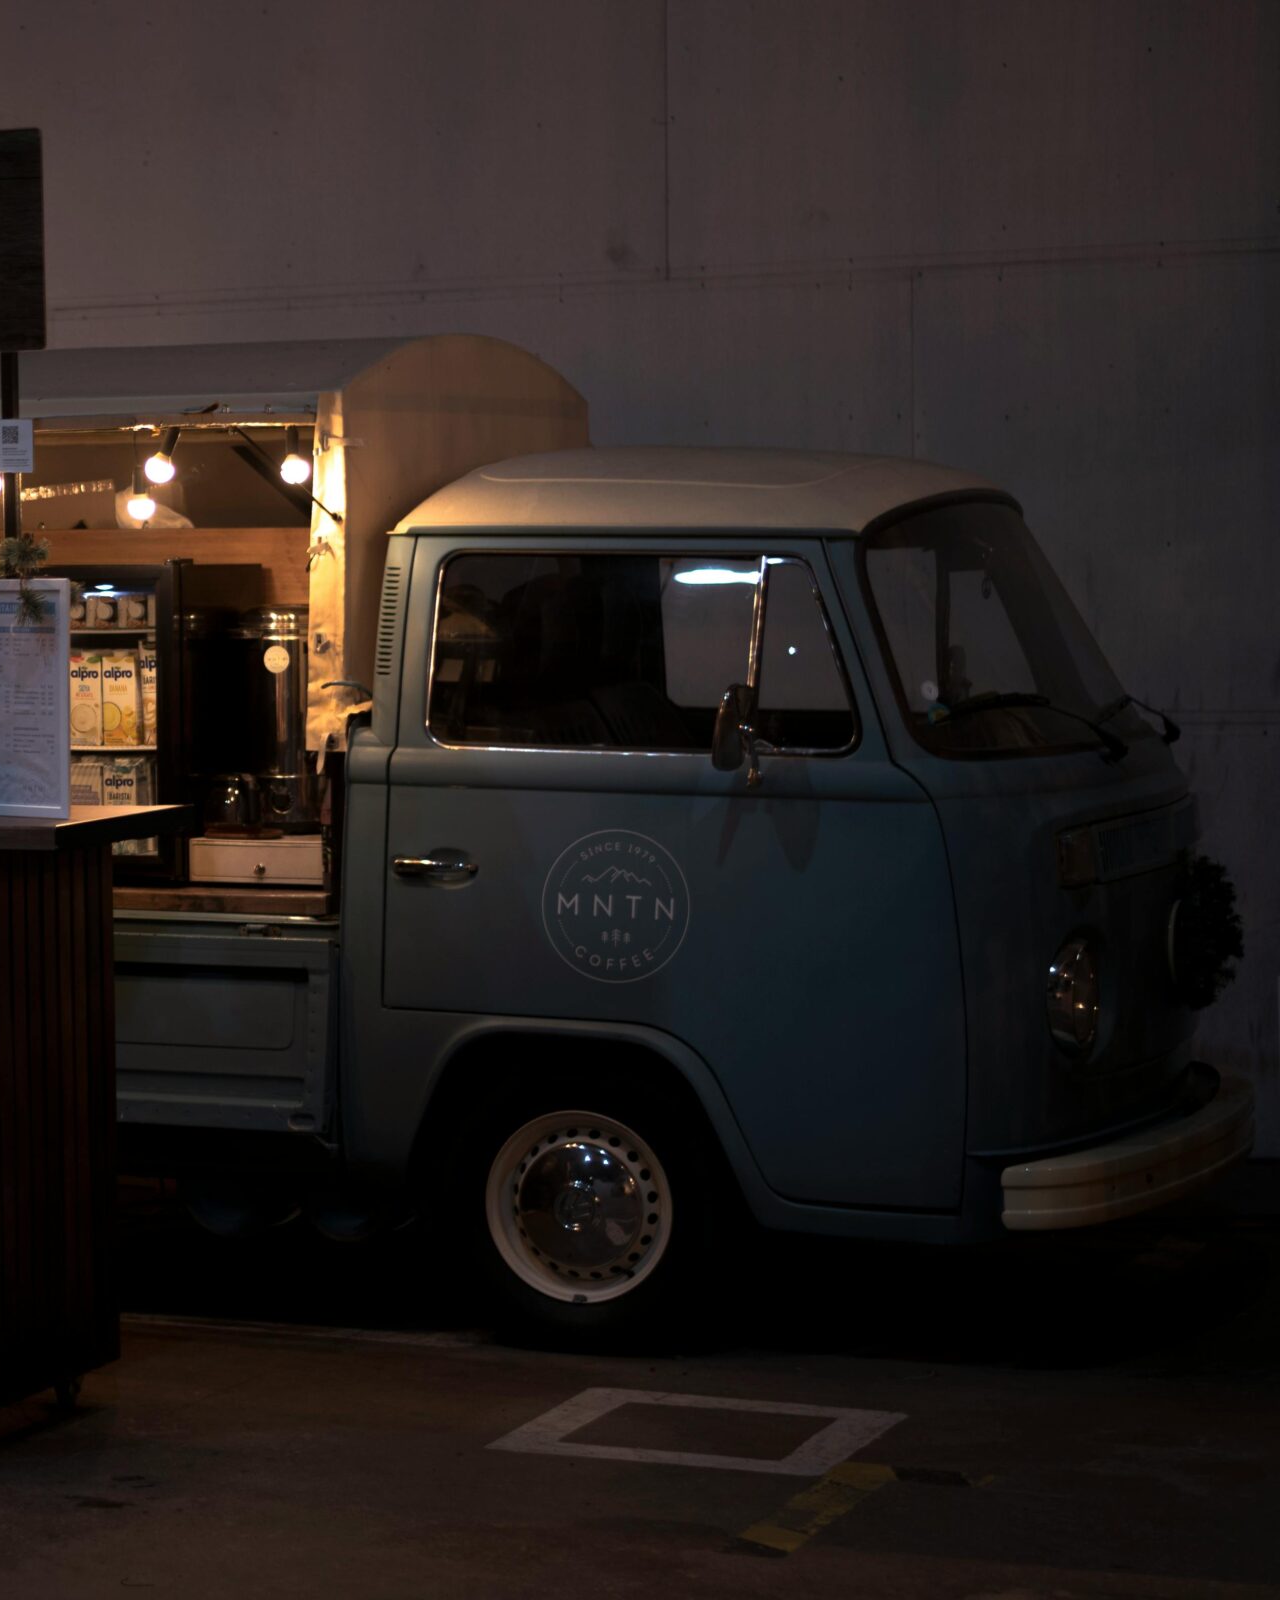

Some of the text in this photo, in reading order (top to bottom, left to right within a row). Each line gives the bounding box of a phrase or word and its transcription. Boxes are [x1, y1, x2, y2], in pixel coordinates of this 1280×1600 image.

[71, 666, 98, 681] alpro
[104, 666, 132, 681] alpro
[104, 774, 134, 789] alpro
[579, 841, 623, 862] SINCE
[556, 891, 676, 921] MNTN
[574, 944, 655, 972] COFFEE
